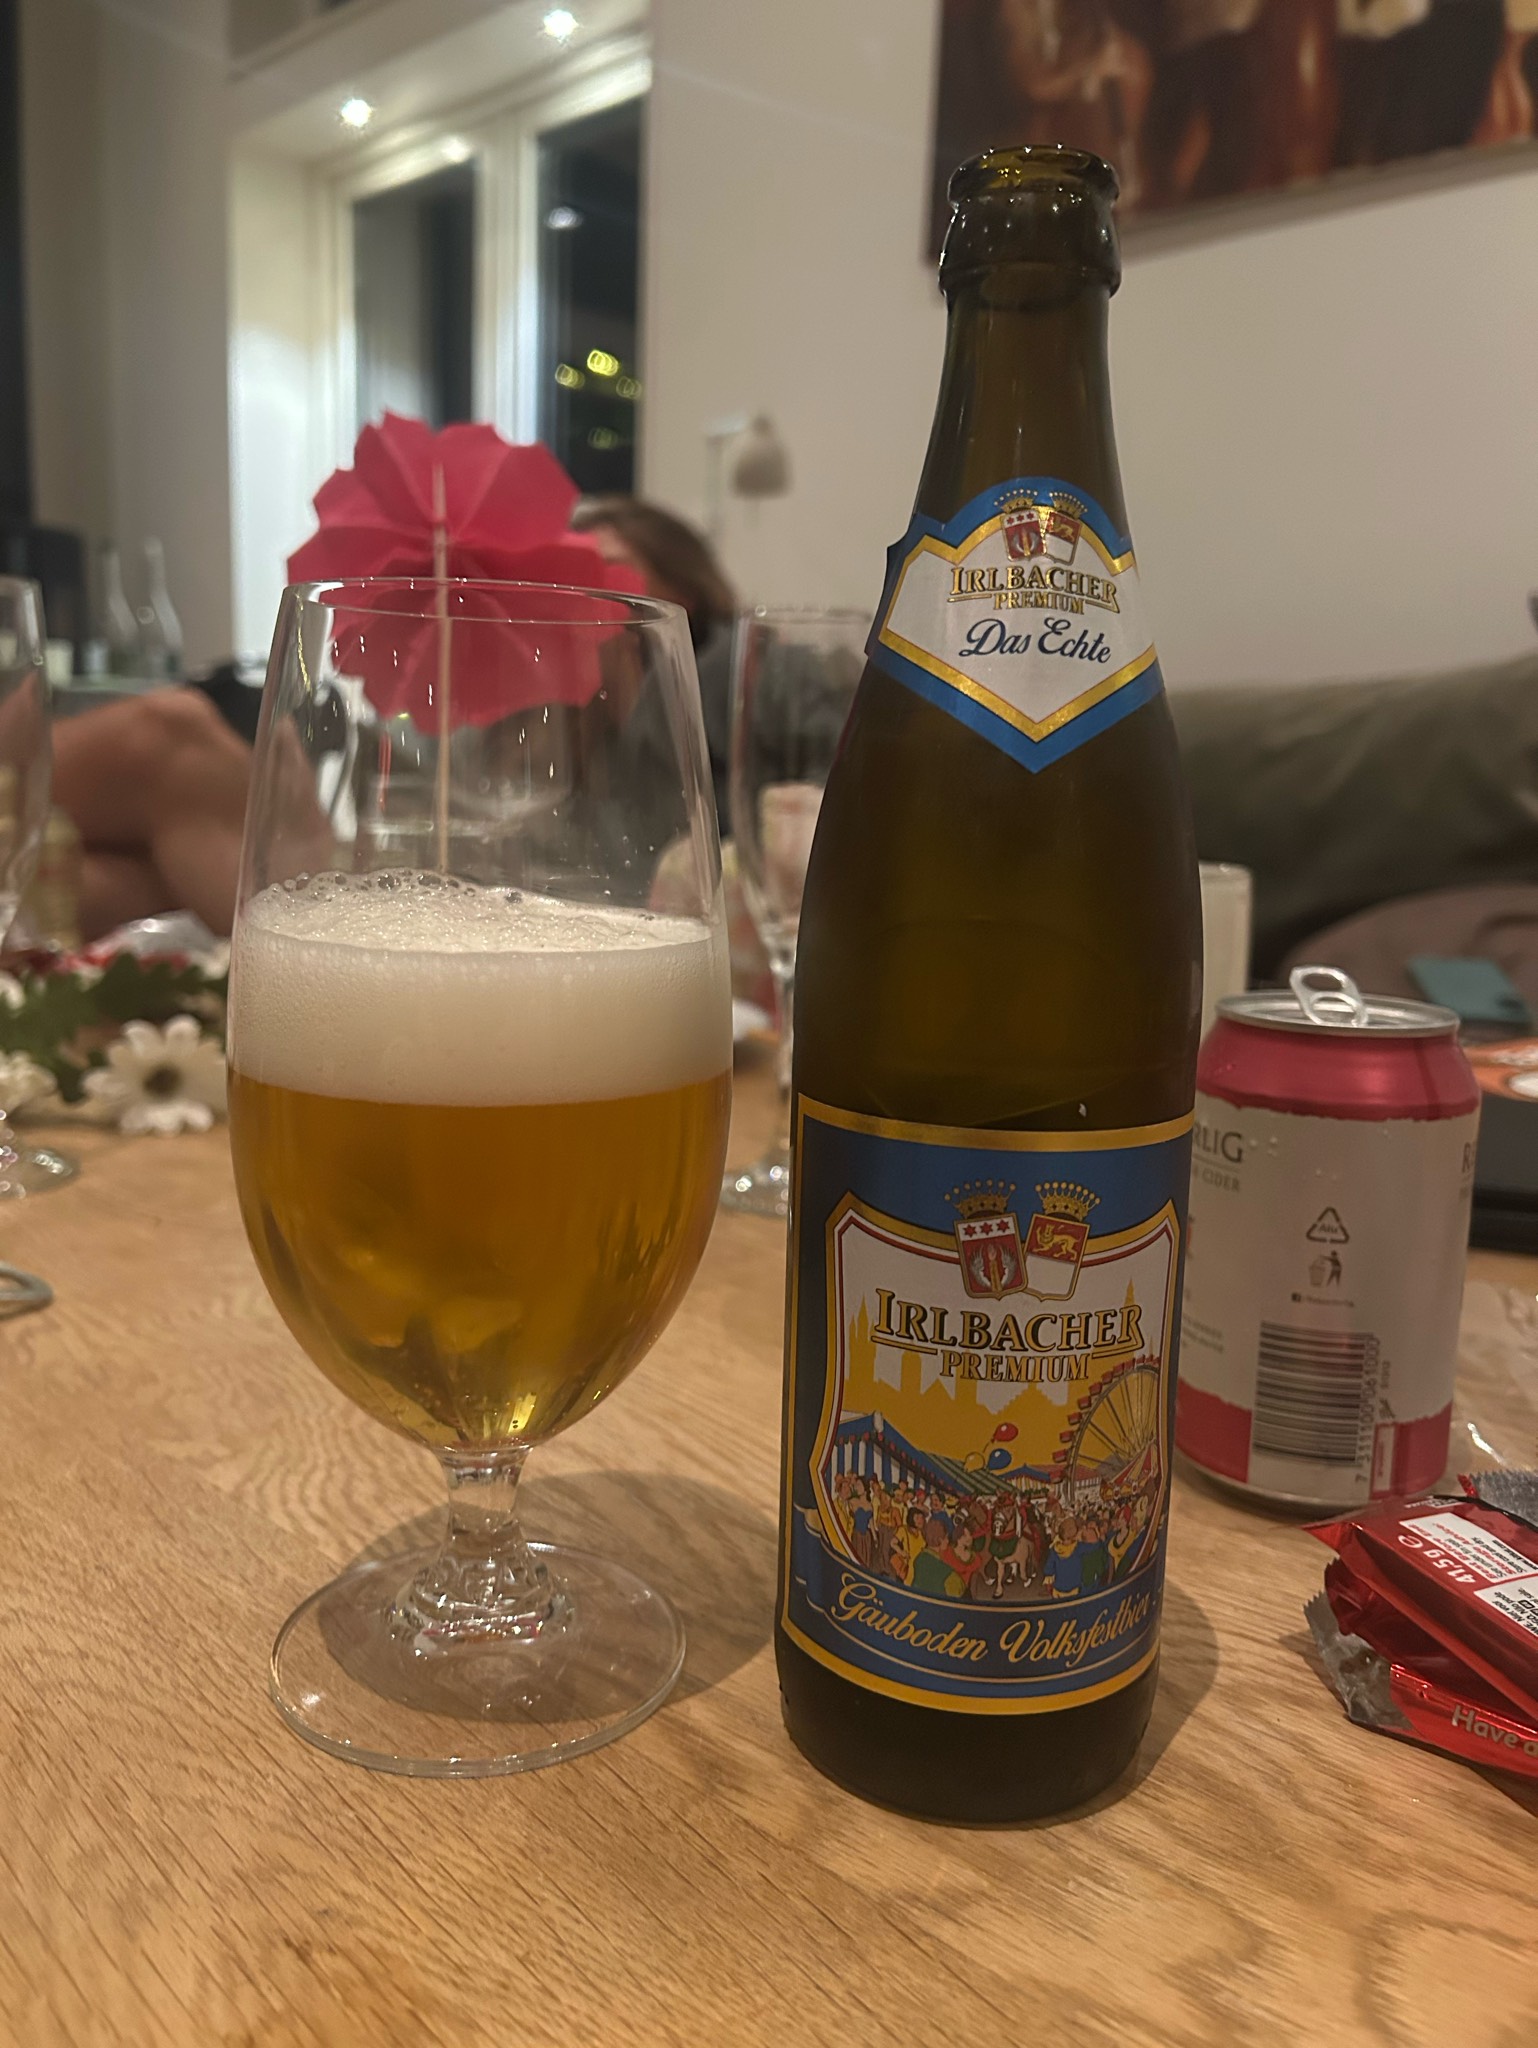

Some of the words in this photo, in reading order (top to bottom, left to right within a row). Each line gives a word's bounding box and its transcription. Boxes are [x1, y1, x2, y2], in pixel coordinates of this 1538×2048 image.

[949, 564, 1119, 605] IRLBACHER
[993, 591, 1085, 615] PREMIUM
[958, 618, 1033, 657] Das
[1037, 617, 1112, 663] Echte
[873, 1288, 1145, 1353] IRLBACHER
[940, 1348, 1091, 1383] PREMIUM
[831, 1574, 990, 1663] Gäuboden
[1451, 1704, 1518, 1748] Have
